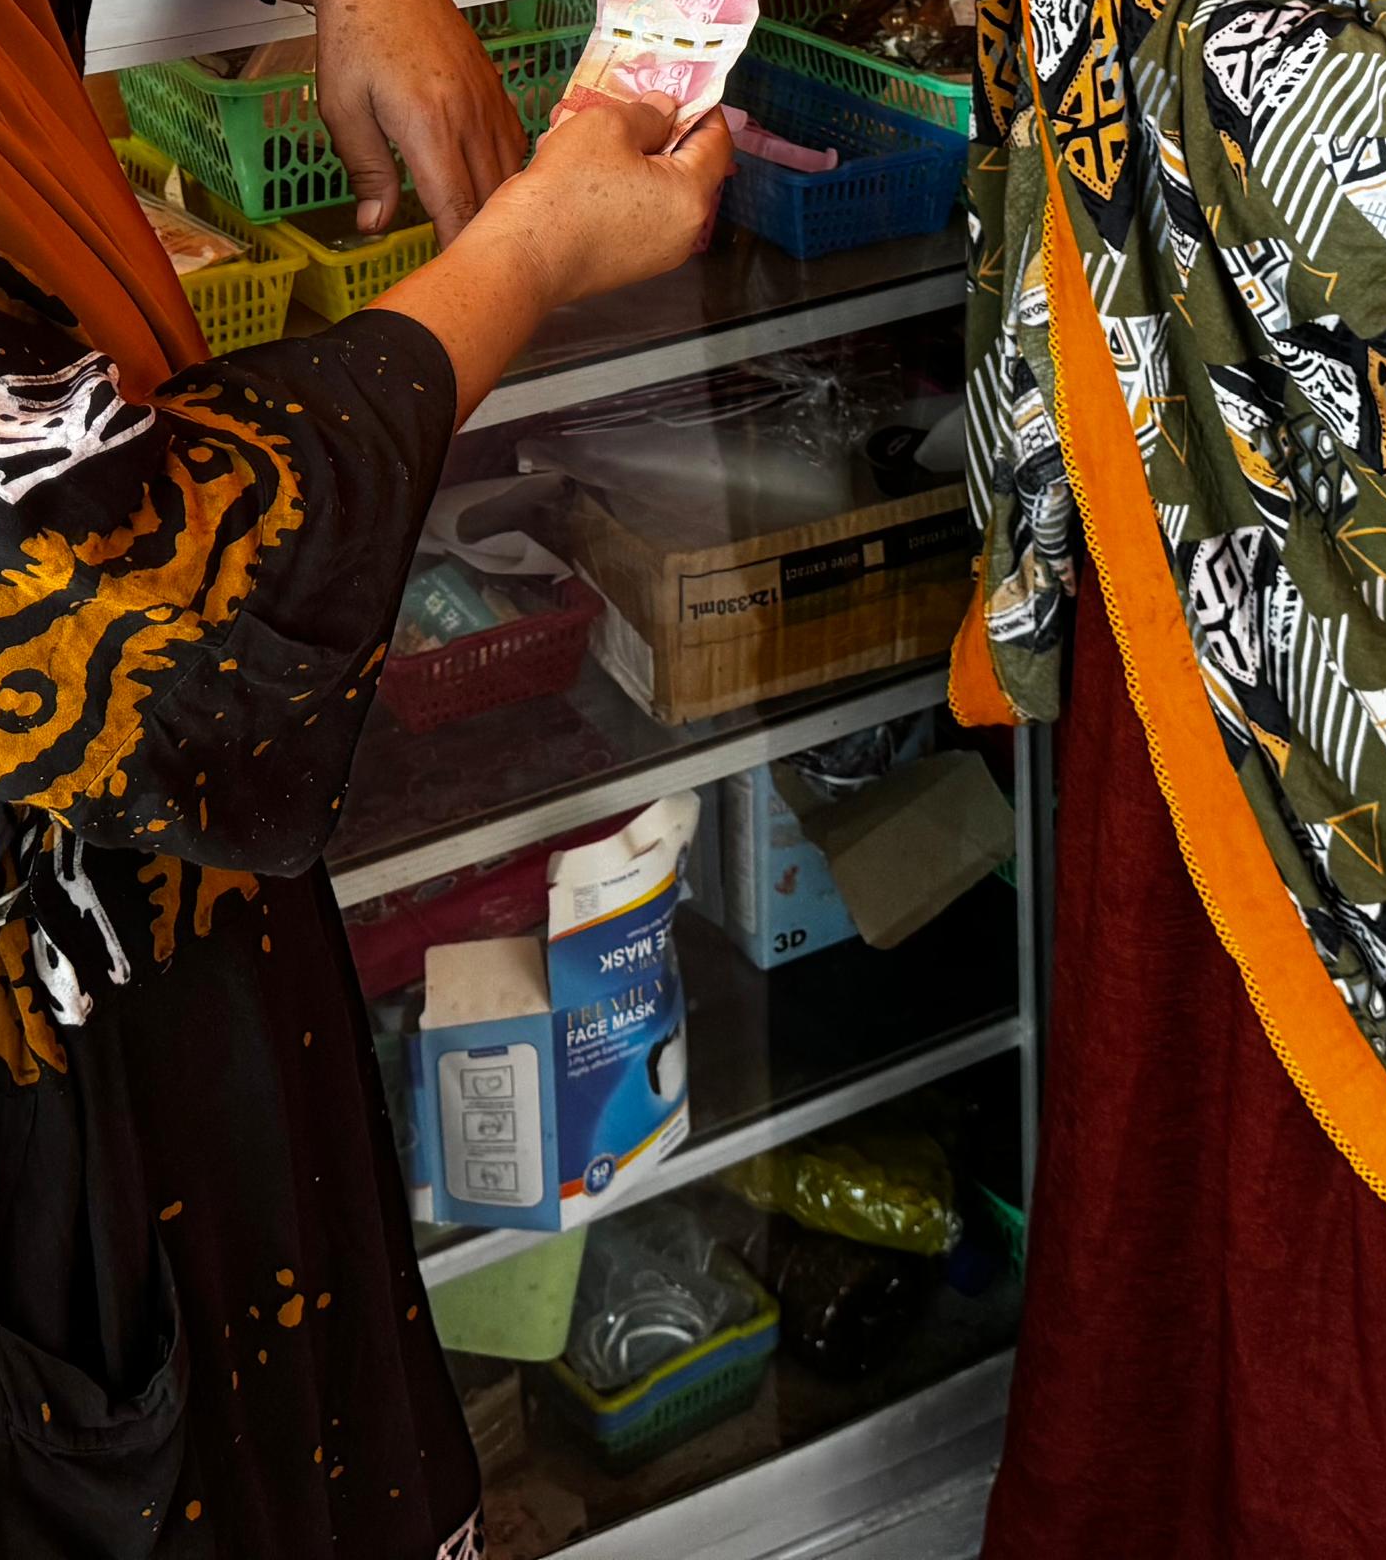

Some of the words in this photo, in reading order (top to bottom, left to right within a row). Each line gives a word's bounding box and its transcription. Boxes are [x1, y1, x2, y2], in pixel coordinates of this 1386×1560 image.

[687, 587, 778, 621] 12x330mL
[599, 936, 652, 974] MASK
[773, 929, 807, 953] 3D
[566, 1018, 608, 1048] FACE
[612, 999, 655, 1030] MASK
[592, 1161, 610, 1181] 50
